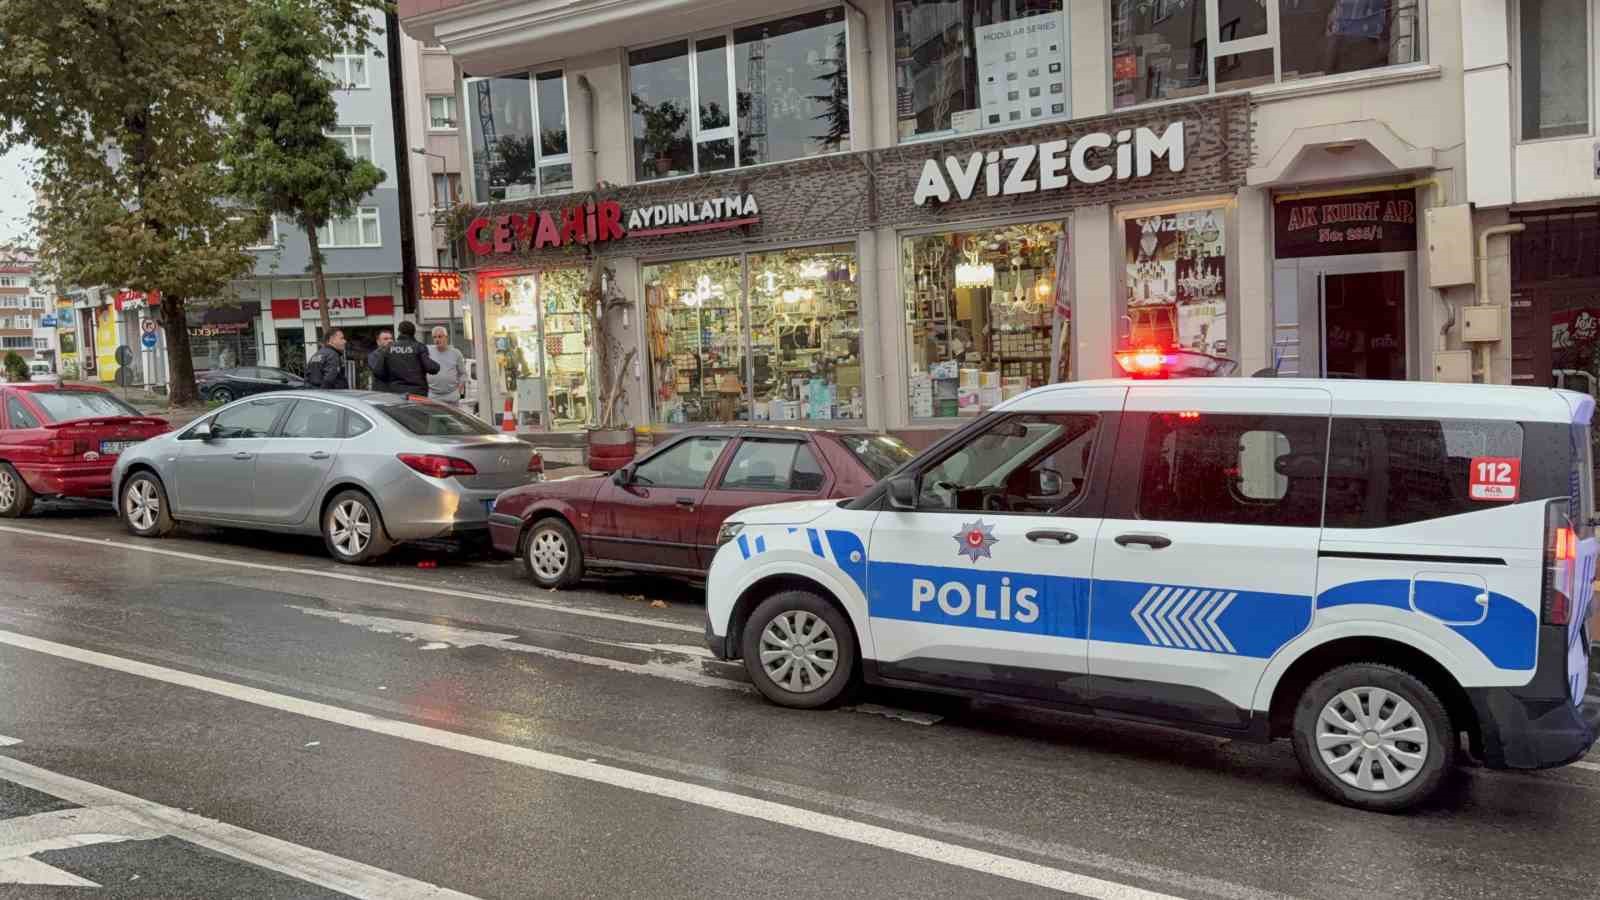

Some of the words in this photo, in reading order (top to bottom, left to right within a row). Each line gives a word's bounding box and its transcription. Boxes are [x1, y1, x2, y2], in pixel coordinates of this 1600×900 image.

[628, 194, 758, 230] AYDINLATMA
[1288, 206, 1318, 232] AK
[1321, 201, 1380, 224] KURT
[302, 298, 362, 311] ECANE
[1477, 462, 1512, 482] 112
[911, 577, 1040, 623] POLİS
